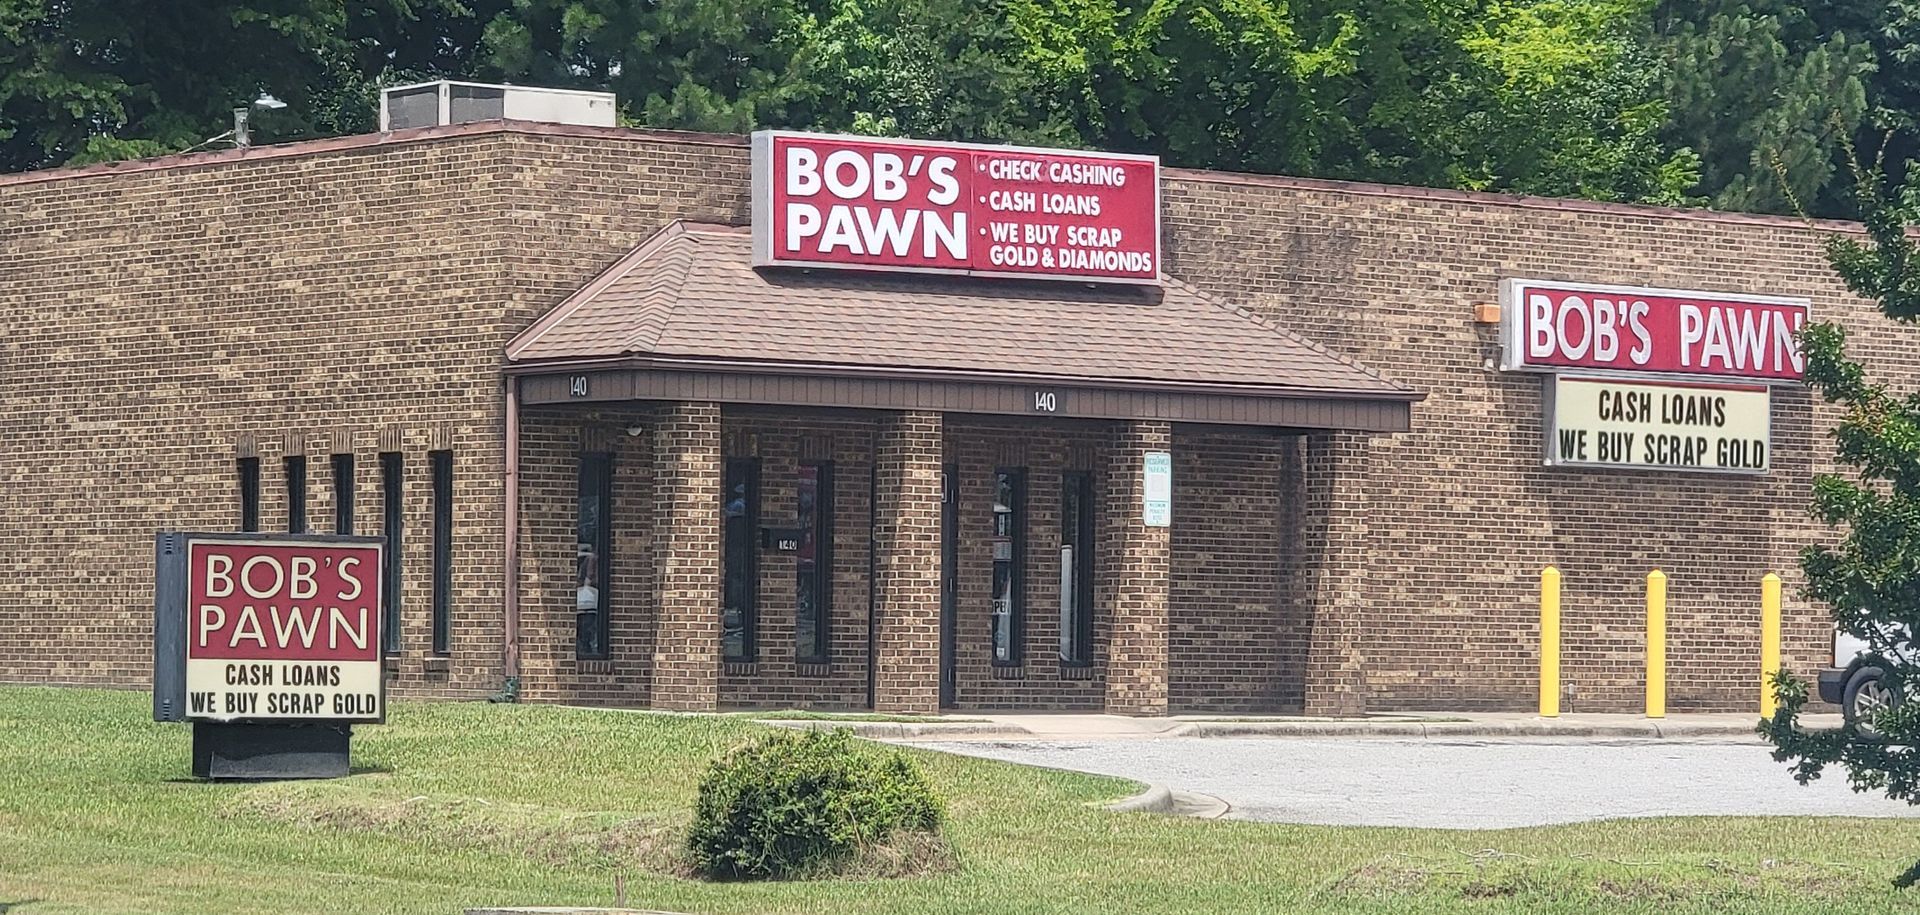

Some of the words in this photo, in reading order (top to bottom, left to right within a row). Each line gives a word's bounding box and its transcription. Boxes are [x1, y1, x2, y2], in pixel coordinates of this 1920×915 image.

[786, 146, 960, 206] BOB'S
[989, 159, 1042, 182] CHECK
[1049, 162, 1126, 187] CASHING
[989, 190, 1036, 213] CASH
[1042, 193, 1101, 217] LOANS
[786, 202, 968, 260] PAWN
[990, 222, 1018, 244] WE
[1024, 223, 1060, 246] BUY
[1067, 225, 1122, 248] SCRAP
[989, 245, 1038, 268] GOLD
[1041, 247, 1055, 269] &
[1058, 248, 1152, 272] DIAMONDS
[1529, 294, 1652, 365] BOB'S
[1680, 304, 1804, 373] PAWN
[570, 376, 587, 396] 140
[1035, 391, 1056, 412] 140
[1599, 389, 1651, 423] CASH
[1662, 393, 1726, 427] LOANS
[1559, 429, 1587, 460] WE
[1600, 430, 1634, 463] BUY
[1644, 434, 1708, 467] SCRAP
[1716, 438, 1764, 469] GOLD
[206, 554, 362, 601] BOB'S
[199, 605, 368, 649] PAWN
[225, 664, 273, 686] CASH
[282, 665, 341, 687] LOANS
[190, 692, 216, 713] WE
[225, 692, 258, 713] BUY
[267, 692, 325, 714] SCRAP
[333, 693, 376, 714] GOLD
